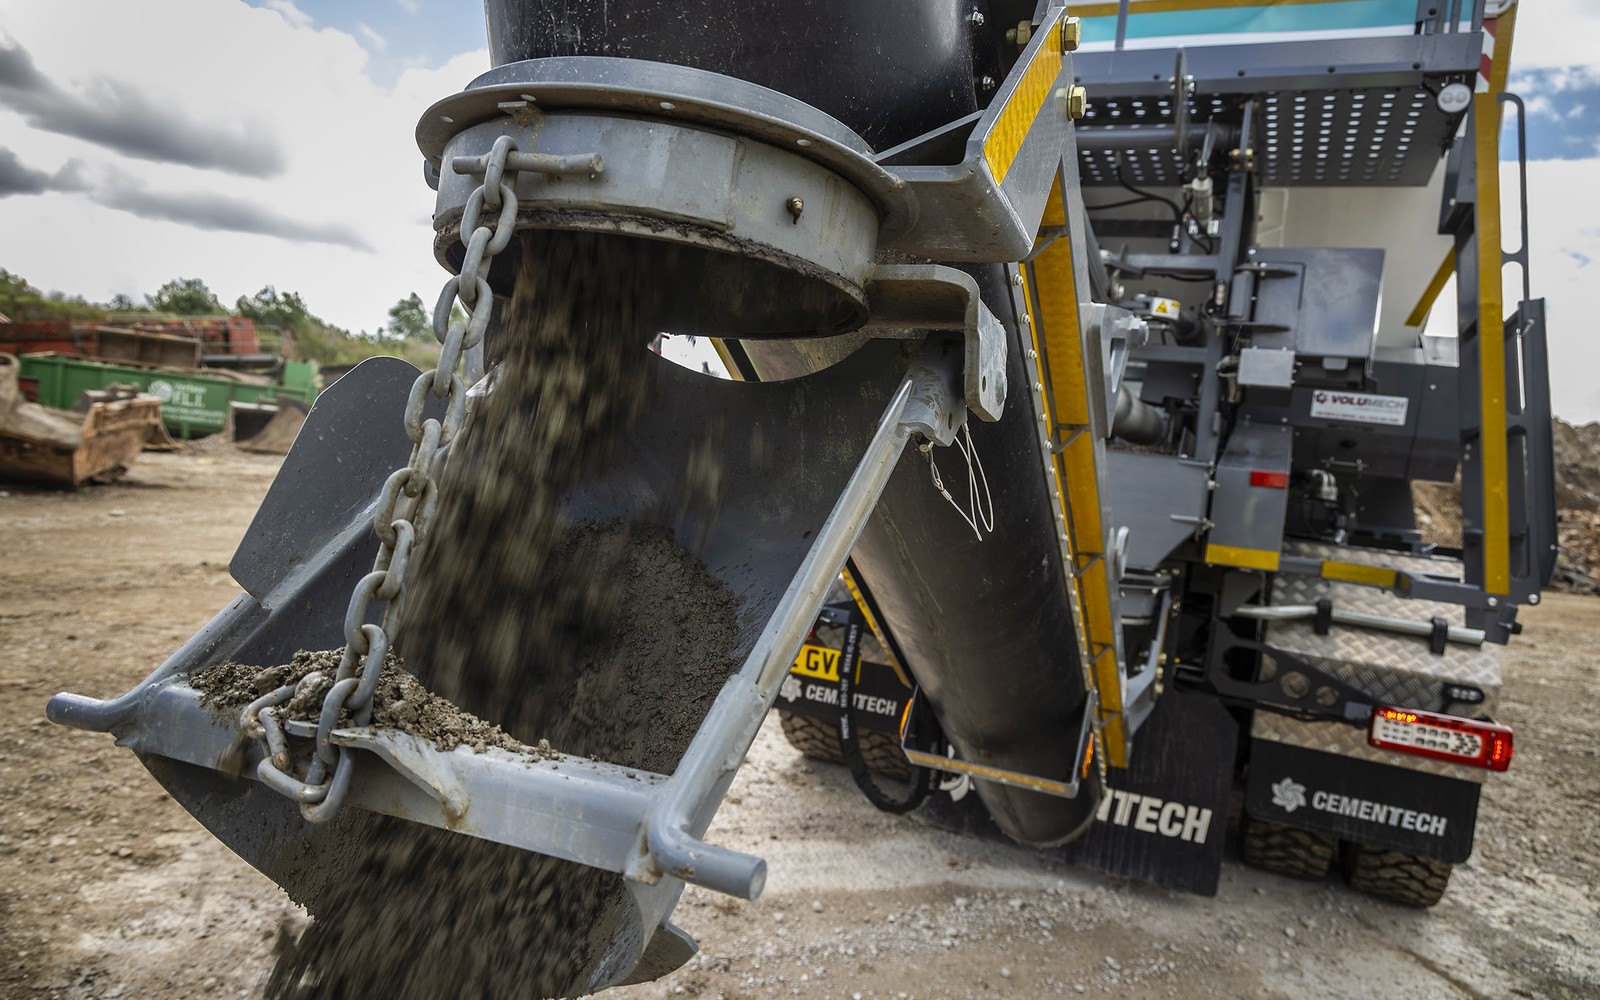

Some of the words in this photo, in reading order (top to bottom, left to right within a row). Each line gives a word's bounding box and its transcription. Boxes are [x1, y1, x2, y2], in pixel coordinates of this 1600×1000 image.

[806, 648, 835, 675] GV
[806, 683, 897, 717] CEMTECH
[1312, 790, 1447, 837] CEMENTECH
